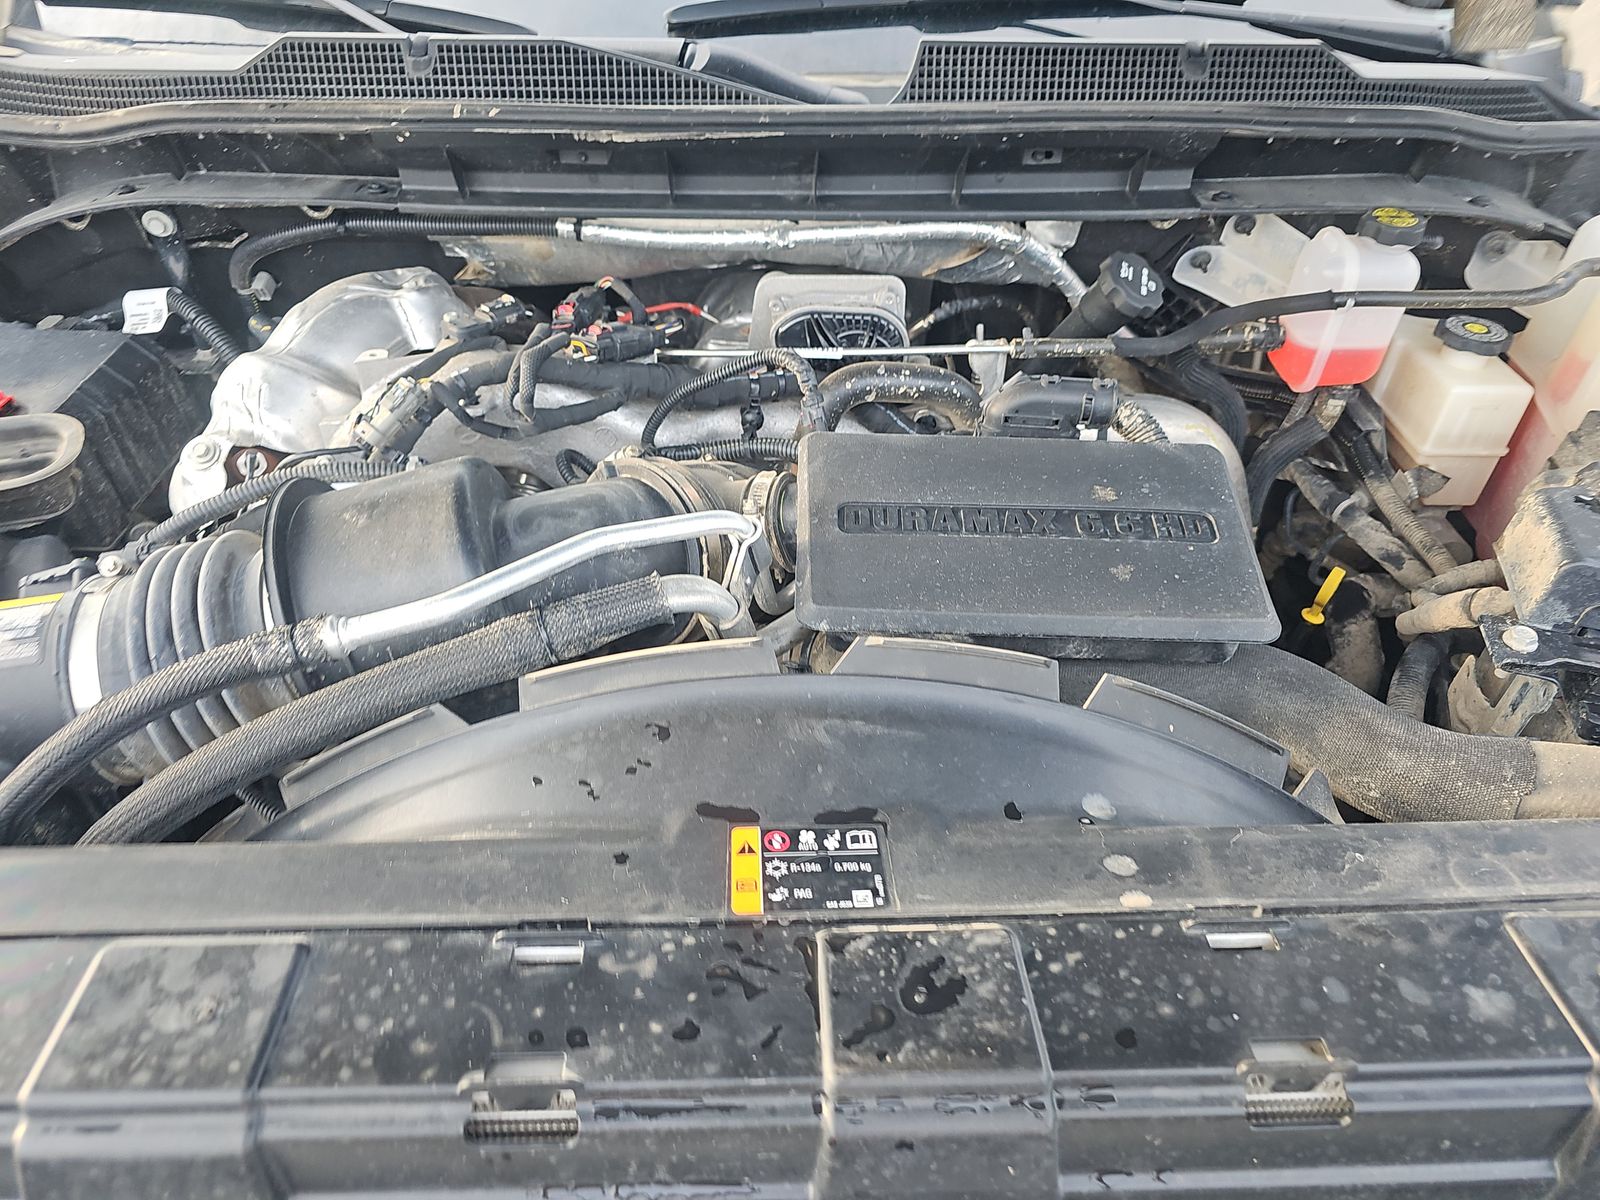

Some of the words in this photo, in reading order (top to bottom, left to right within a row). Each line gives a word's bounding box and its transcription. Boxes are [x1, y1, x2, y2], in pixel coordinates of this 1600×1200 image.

[843, 504, 1058, 535] DURAMAX
[1075, 510, 1143, 537] 6.6
[1150, 511, 1214, 541] HD
[798, 842, 819, 851] AUTO
[859, 861, 872, 873] kg
[793, 887, 813, 899] PAG
